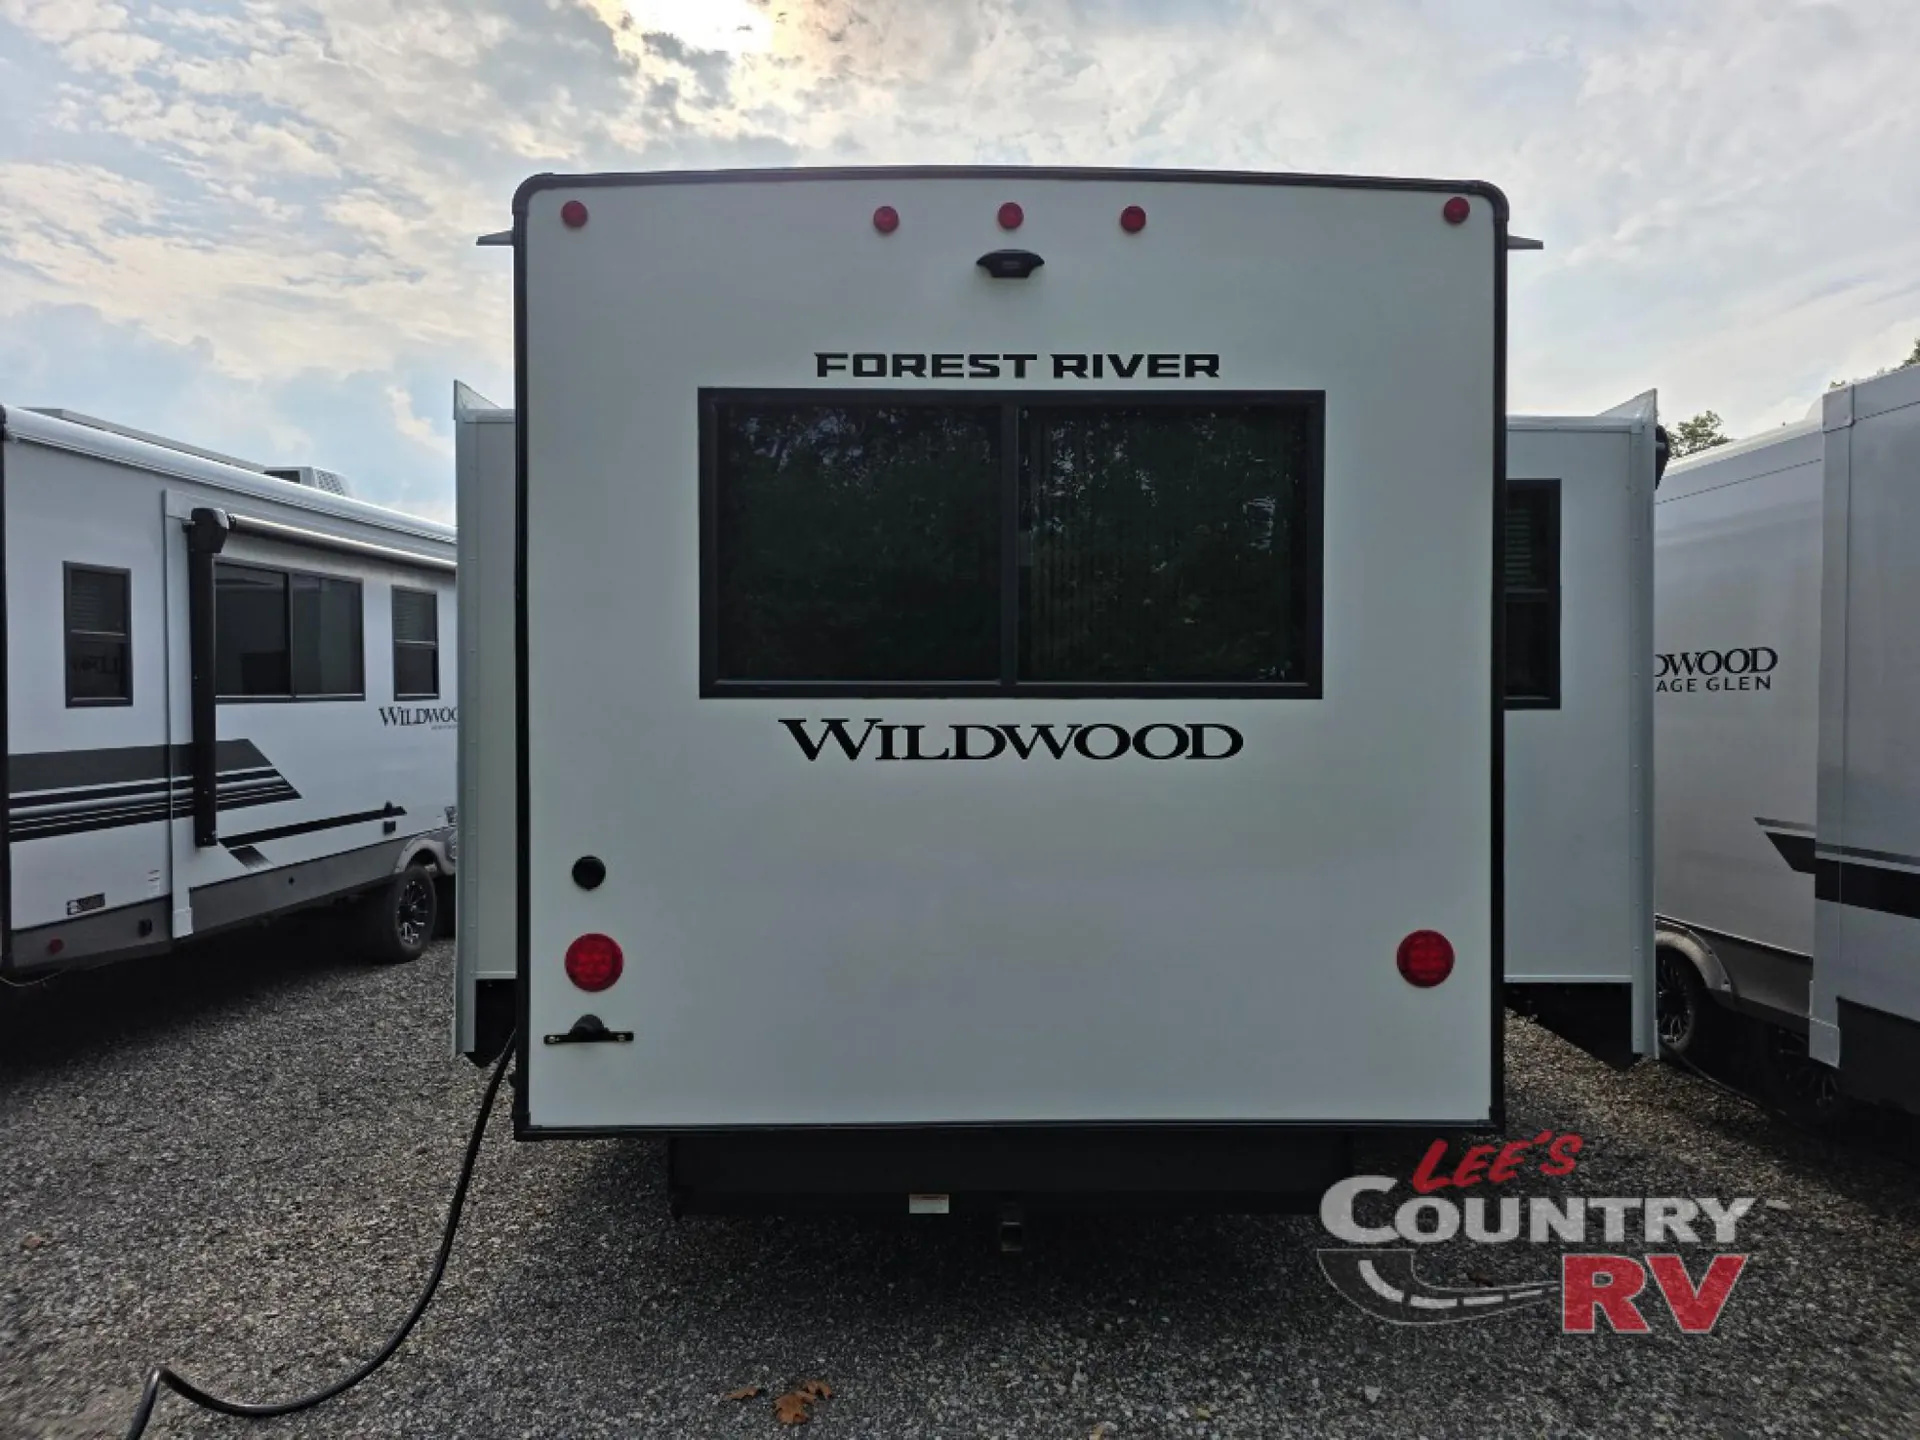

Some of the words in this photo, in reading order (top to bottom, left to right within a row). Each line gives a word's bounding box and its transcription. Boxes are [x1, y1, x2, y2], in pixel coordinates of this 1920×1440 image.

[814, 353, 1037, 379] FOREST
[1049, 353, 1220, 379] RIVER
[1655, 678, 1697, 693] AGE
[1705, 675, 1771, 692] GLEN
[778, 718, 1244, 762] WILDWOOD
